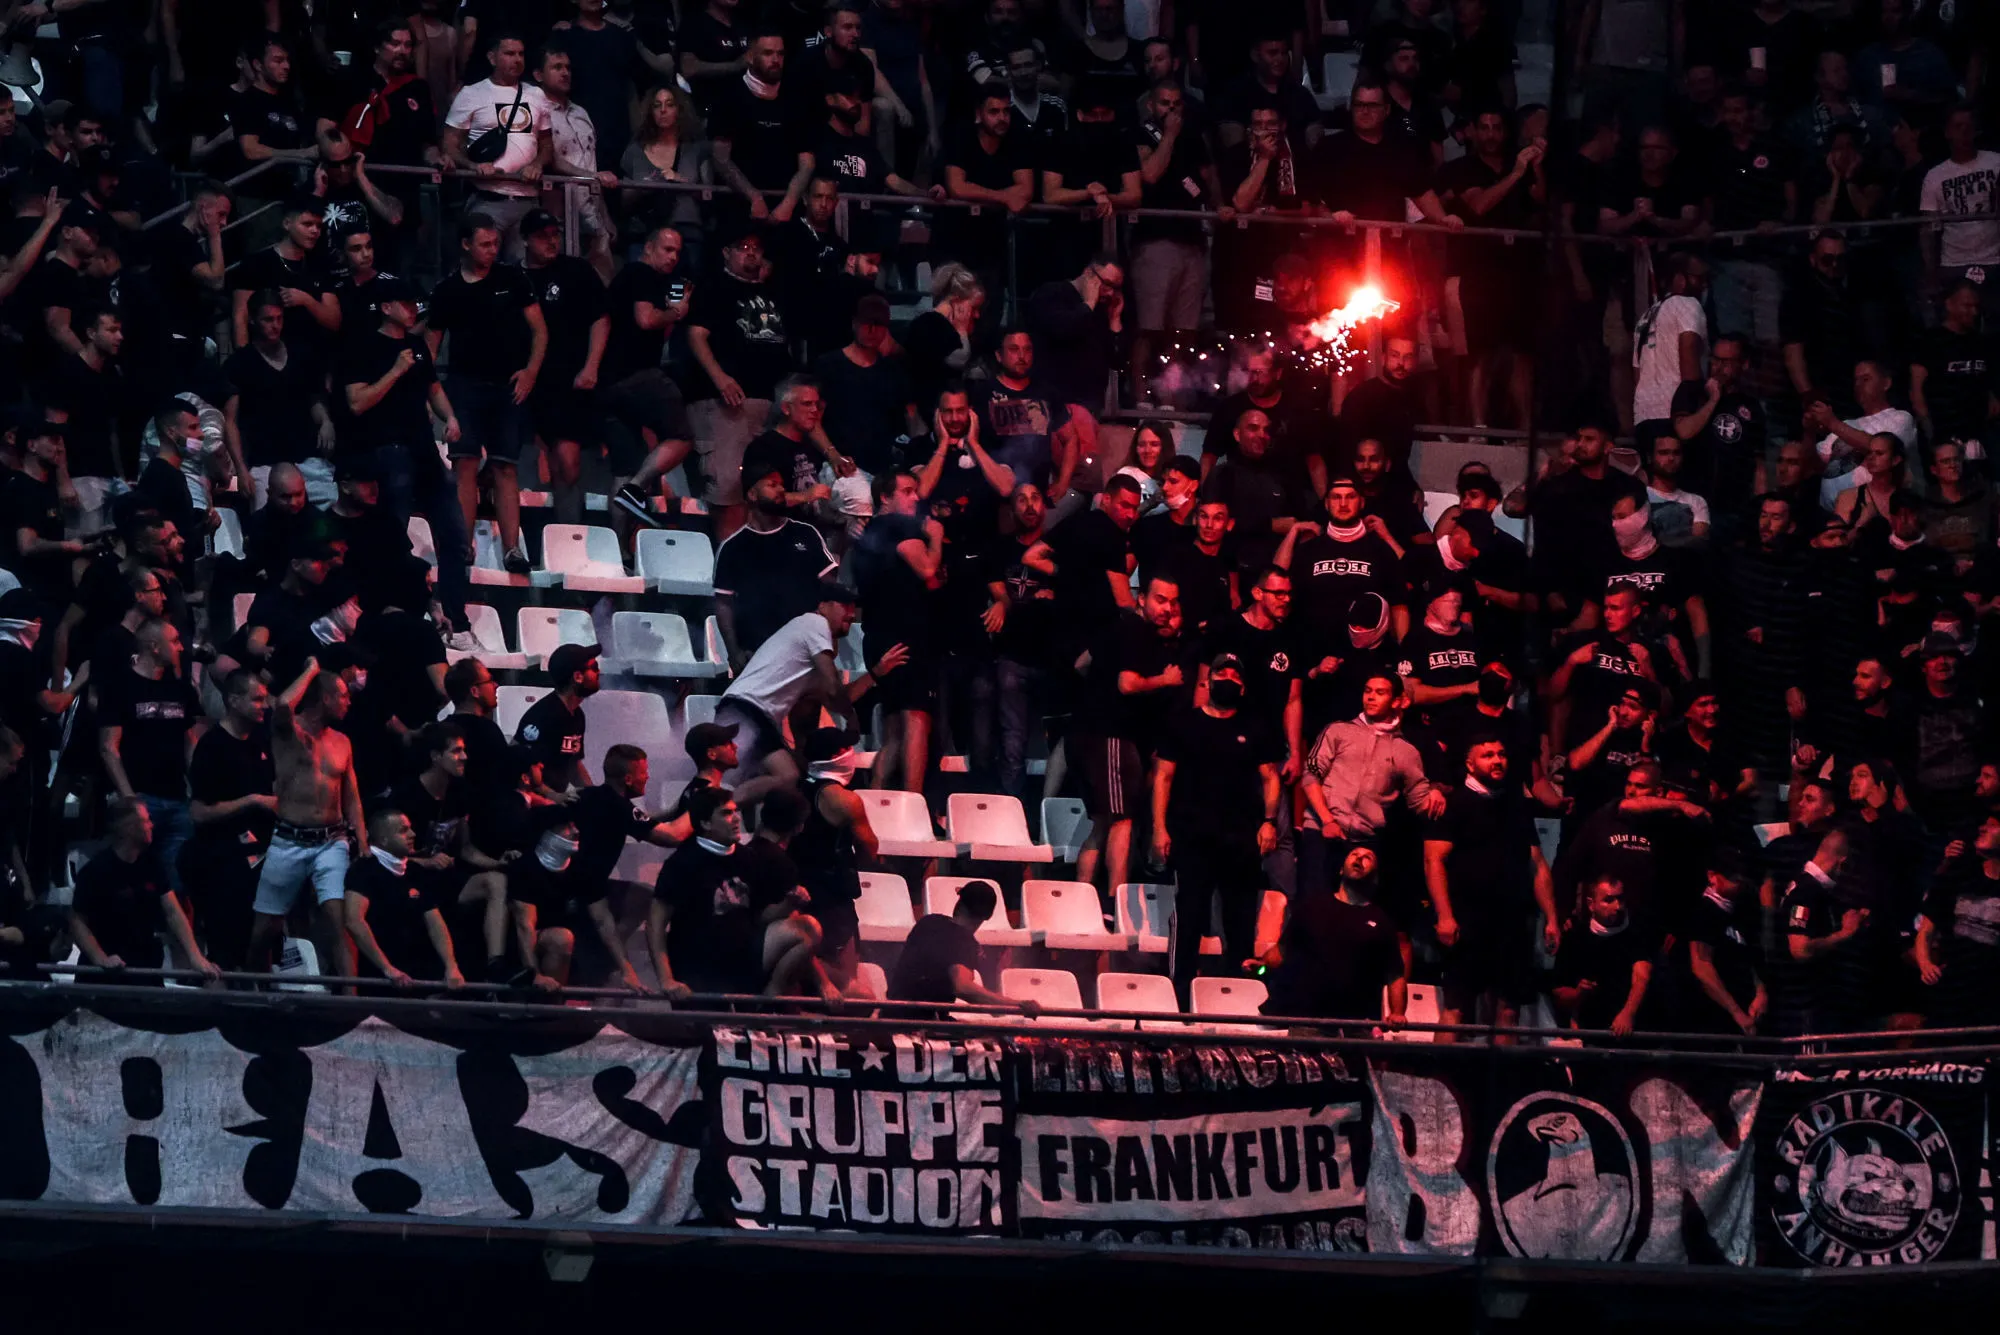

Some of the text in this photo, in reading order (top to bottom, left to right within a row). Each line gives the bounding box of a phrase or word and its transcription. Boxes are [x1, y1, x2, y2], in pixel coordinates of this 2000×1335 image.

[1942, 170, 1995, 191] EUROPA
[713, 1028, 1002, 1084] EHRE DER
[720, 1076, 1003, 1164] GRUPPE
[1779, 1091, 1945, 1167] RADIKALE
[727, 1155, 1003, 1229] STADION
[1038, 1120, 1372, 1203] FRANKFURT
